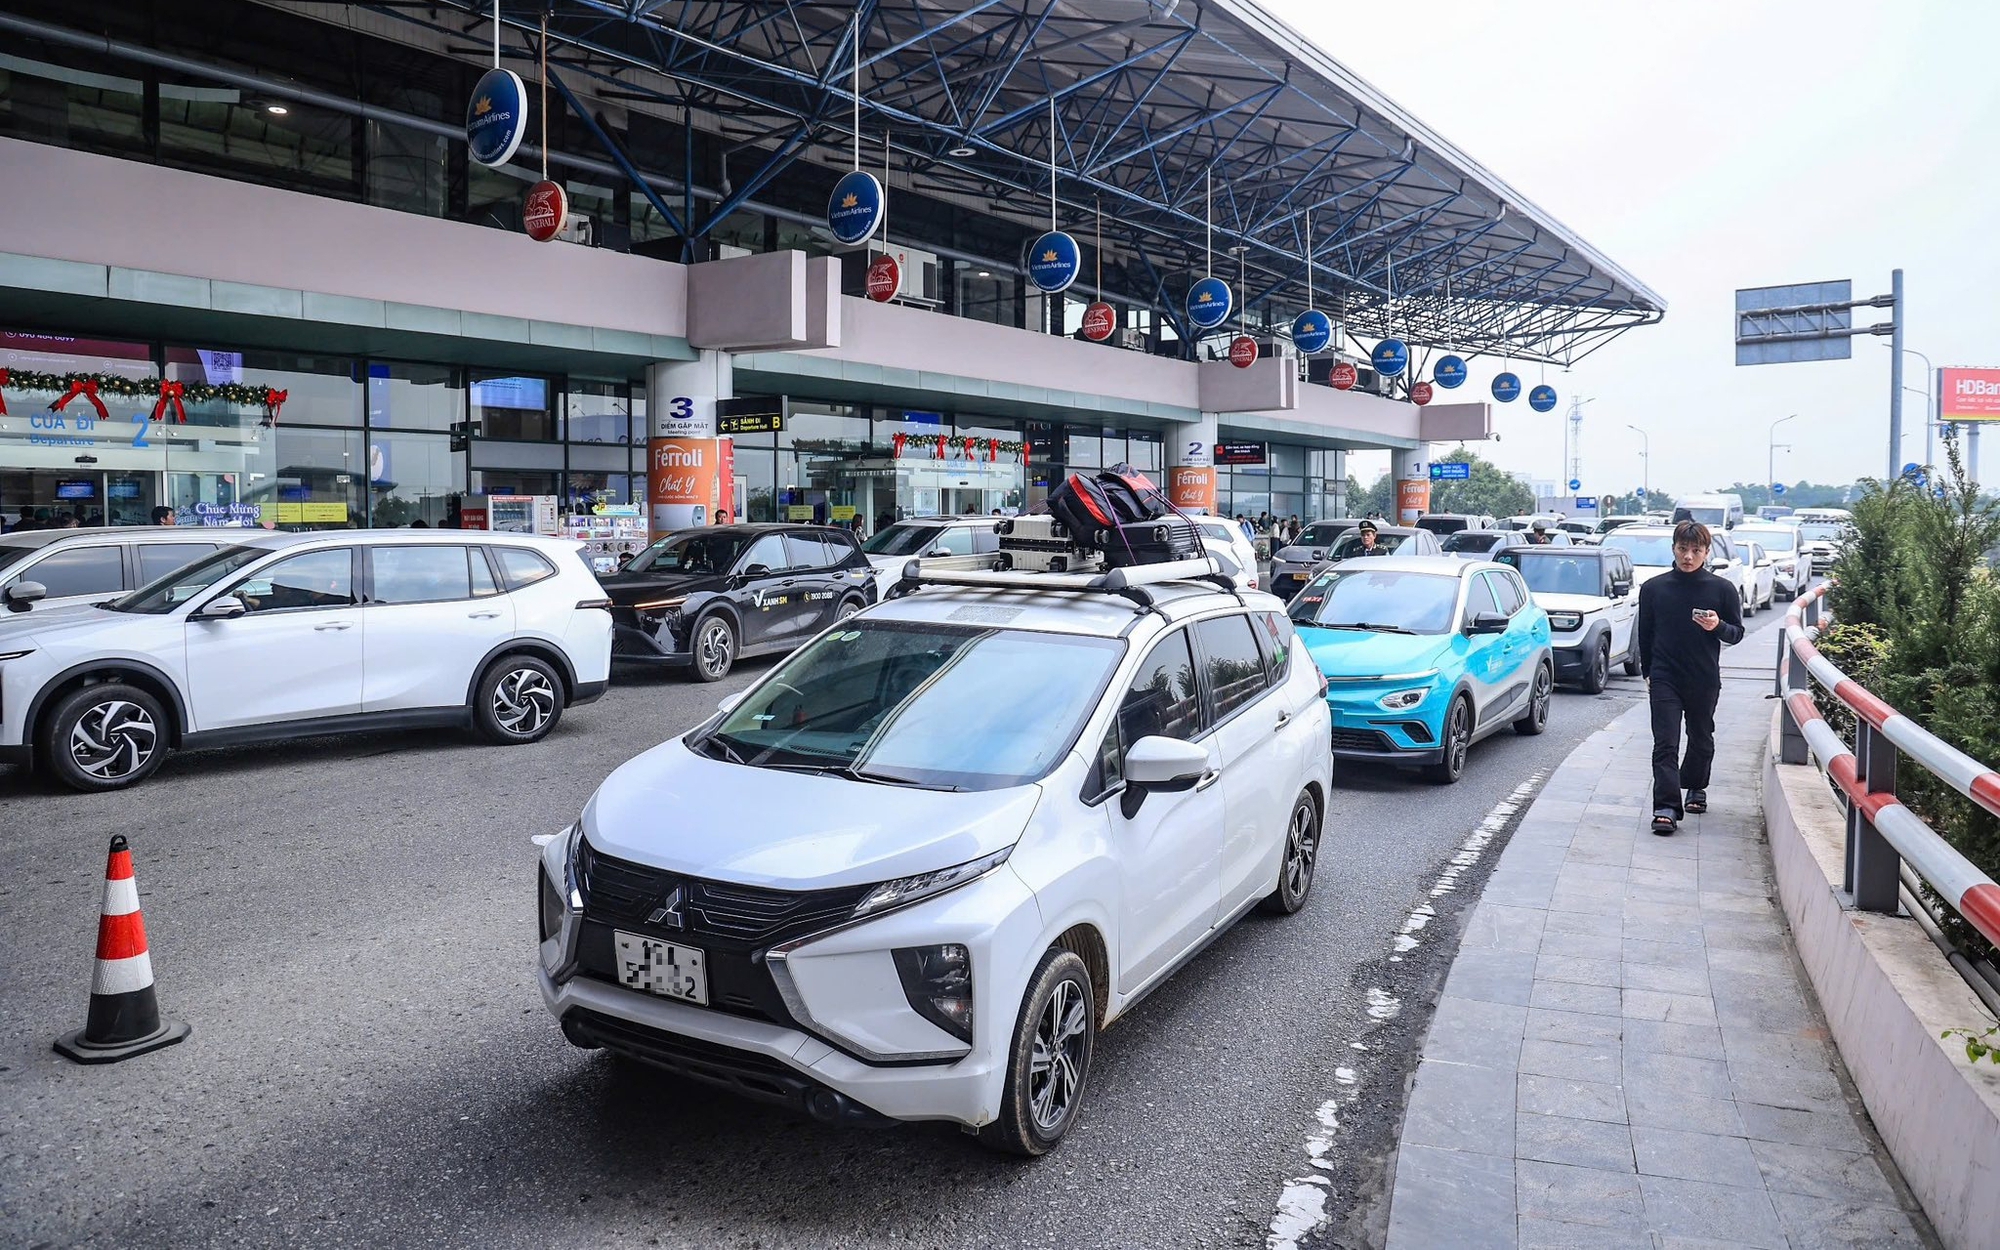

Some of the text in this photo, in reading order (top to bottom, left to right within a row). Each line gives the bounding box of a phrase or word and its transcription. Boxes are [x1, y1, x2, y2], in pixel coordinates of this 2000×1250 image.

[670, 397, 694, 418] 3
[132, 413, 149, 447] 2
[772, 416, 780, 429] B
[30, 433, 94, 446] Departure
[1188, 441, 1203, 455] 2
[655, 447, 702, 470] Ferroli
[1413, 463, 1420, 472] 1
[1177, 471, 1207, 487] Ferroli
[196, 502, 226, 514] Chúc
[229, 502, 261, 519] Mừng
[763, 596, 788, 606] XANH SM
